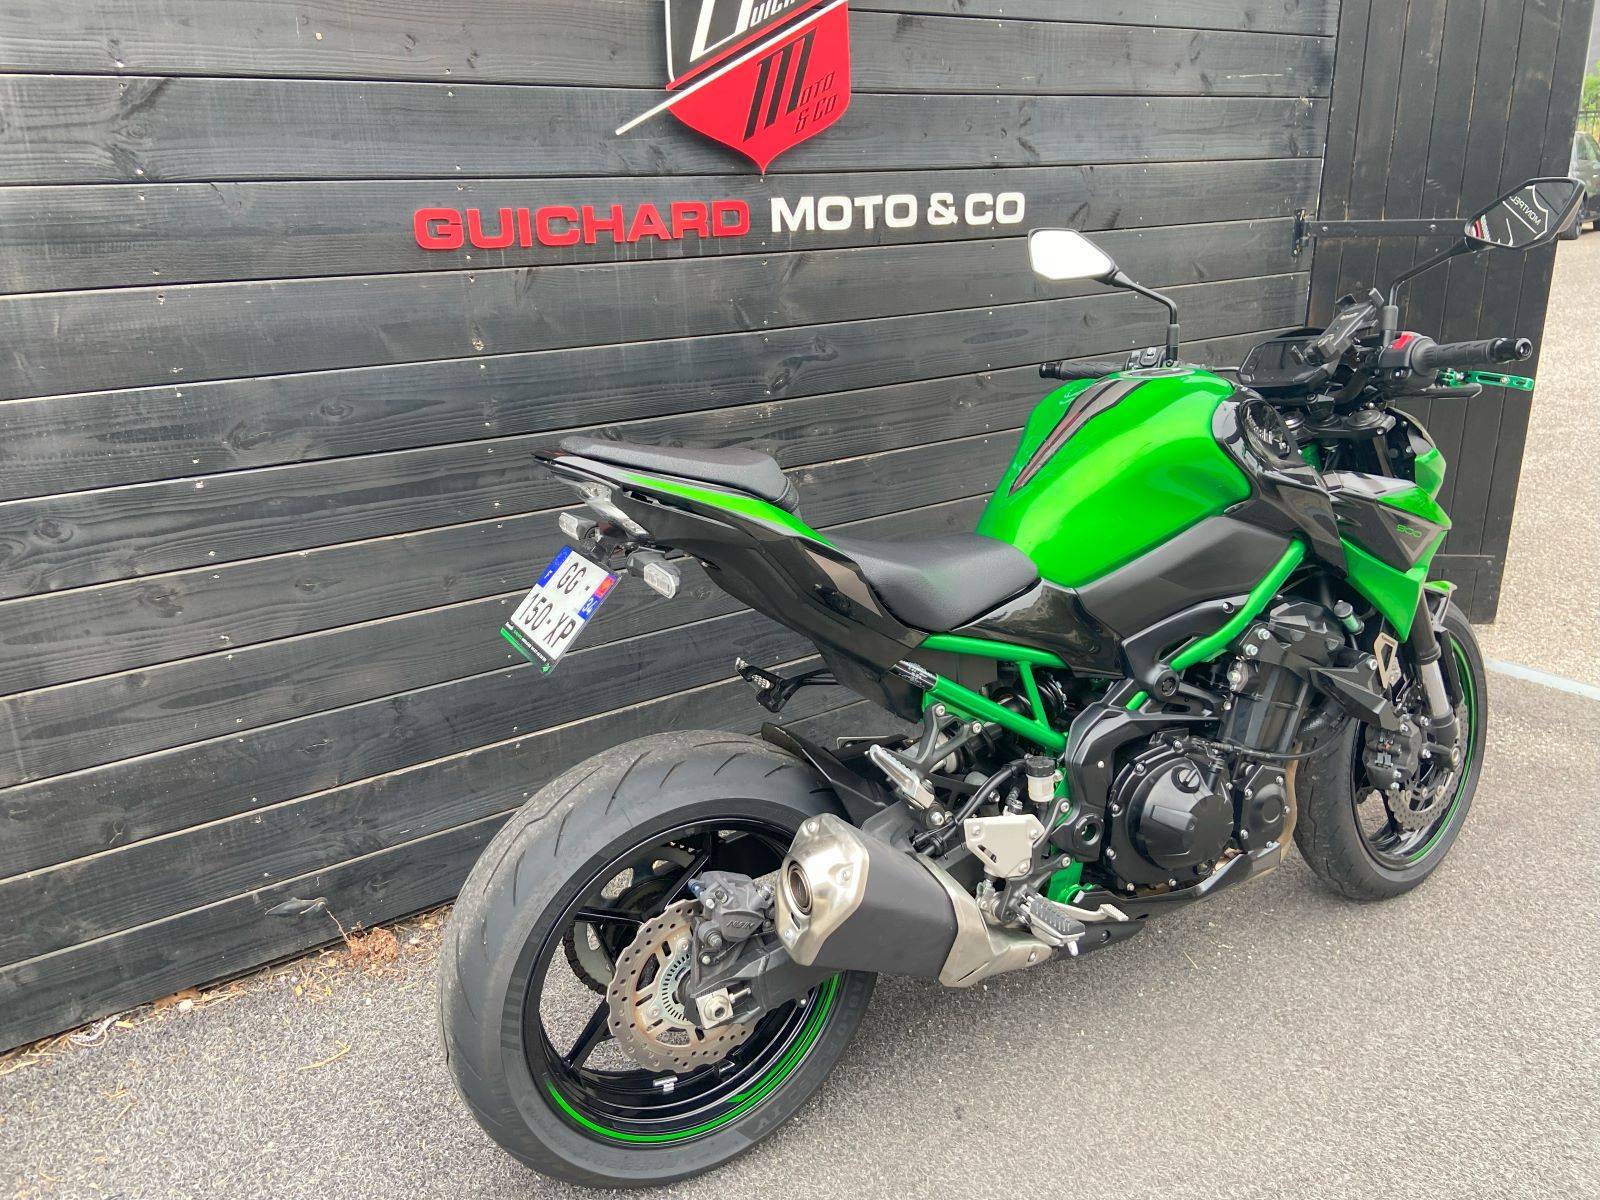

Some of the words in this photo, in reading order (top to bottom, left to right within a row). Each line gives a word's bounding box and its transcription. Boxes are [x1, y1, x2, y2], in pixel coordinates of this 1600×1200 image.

[413, 199, 751, 250] GUICHARD
[771, 194, 918, 233] MOTO
[926, 192, 959, 226] &
[964, 192, 1026, 226] CO
